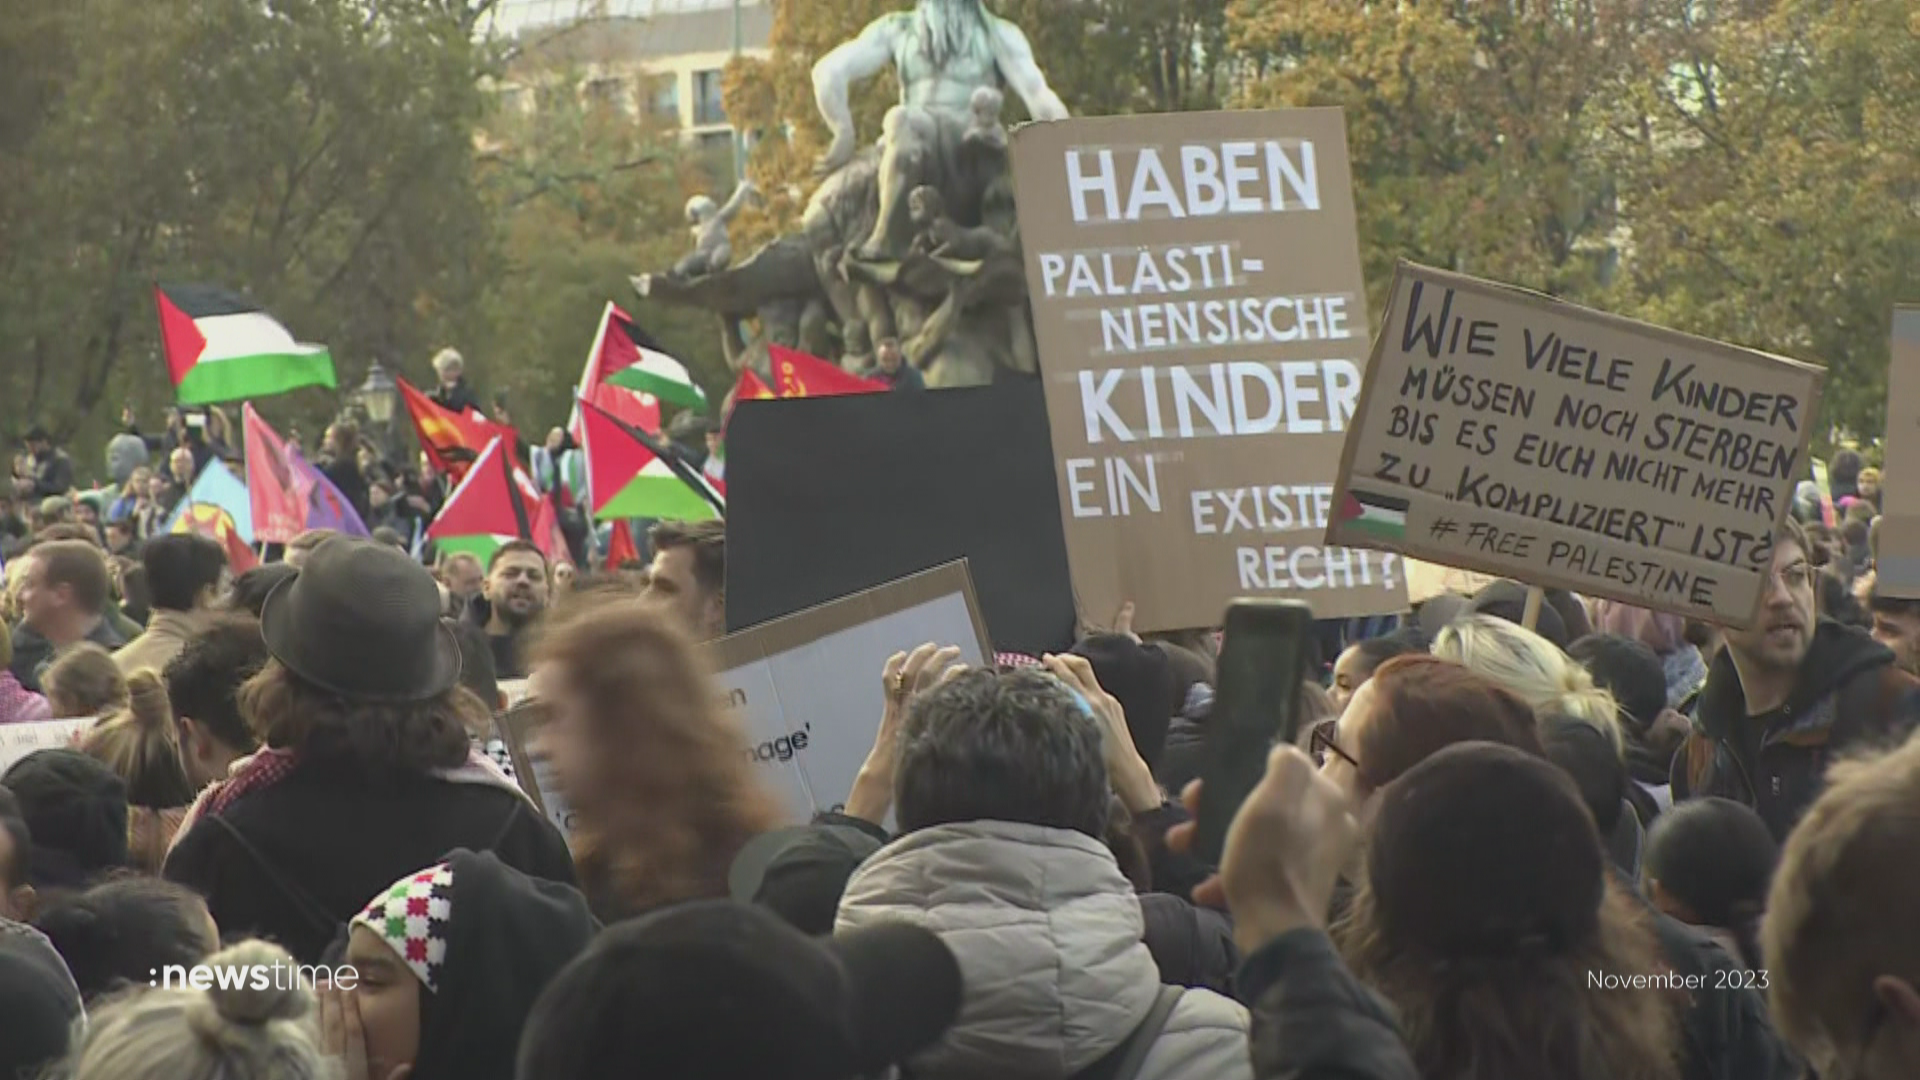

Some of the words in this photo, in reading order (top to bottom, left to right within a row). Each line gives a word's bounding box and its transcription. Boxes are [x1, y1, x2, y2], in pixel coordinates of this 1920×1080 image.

[1064, 141, 1320, 222] HABEN
[1040, 244, 1264, 298] PALÄSTI-
[1100, 297, 1351, 352] NENSISCHE
[1402, 280, 1498, 359] WIE
[1524, 328, 1634, 391] VIELE
[1651, 358, 1798, 432] KINDER
[1078, 358, 1359, 444] KINDER
[1400, 364, 1536, 419] MÜSSEN
[1554, 393, 1639, 443] NOCH
[1644, 413, 1798, 480] STERBEN
[1066, 454, 1161, 518] EIN
[1374, 452, 1432, 489] ZU
[1386, 405, 1439, 446] BIS
[1456, 419, 1498, 456] ES
[1514, 433, 1596, 478] EUCH
[1603, 450, 1689, 495] NICHT
[1691, 472, 1775, 521] MEHR
[1236, 546, 1398, 590] RECHT?
[1430, 515, 1459, 541] #
[1465, 522, 1538, 558] FREE
[1546, 540, 1718, 605] PALESTINE
